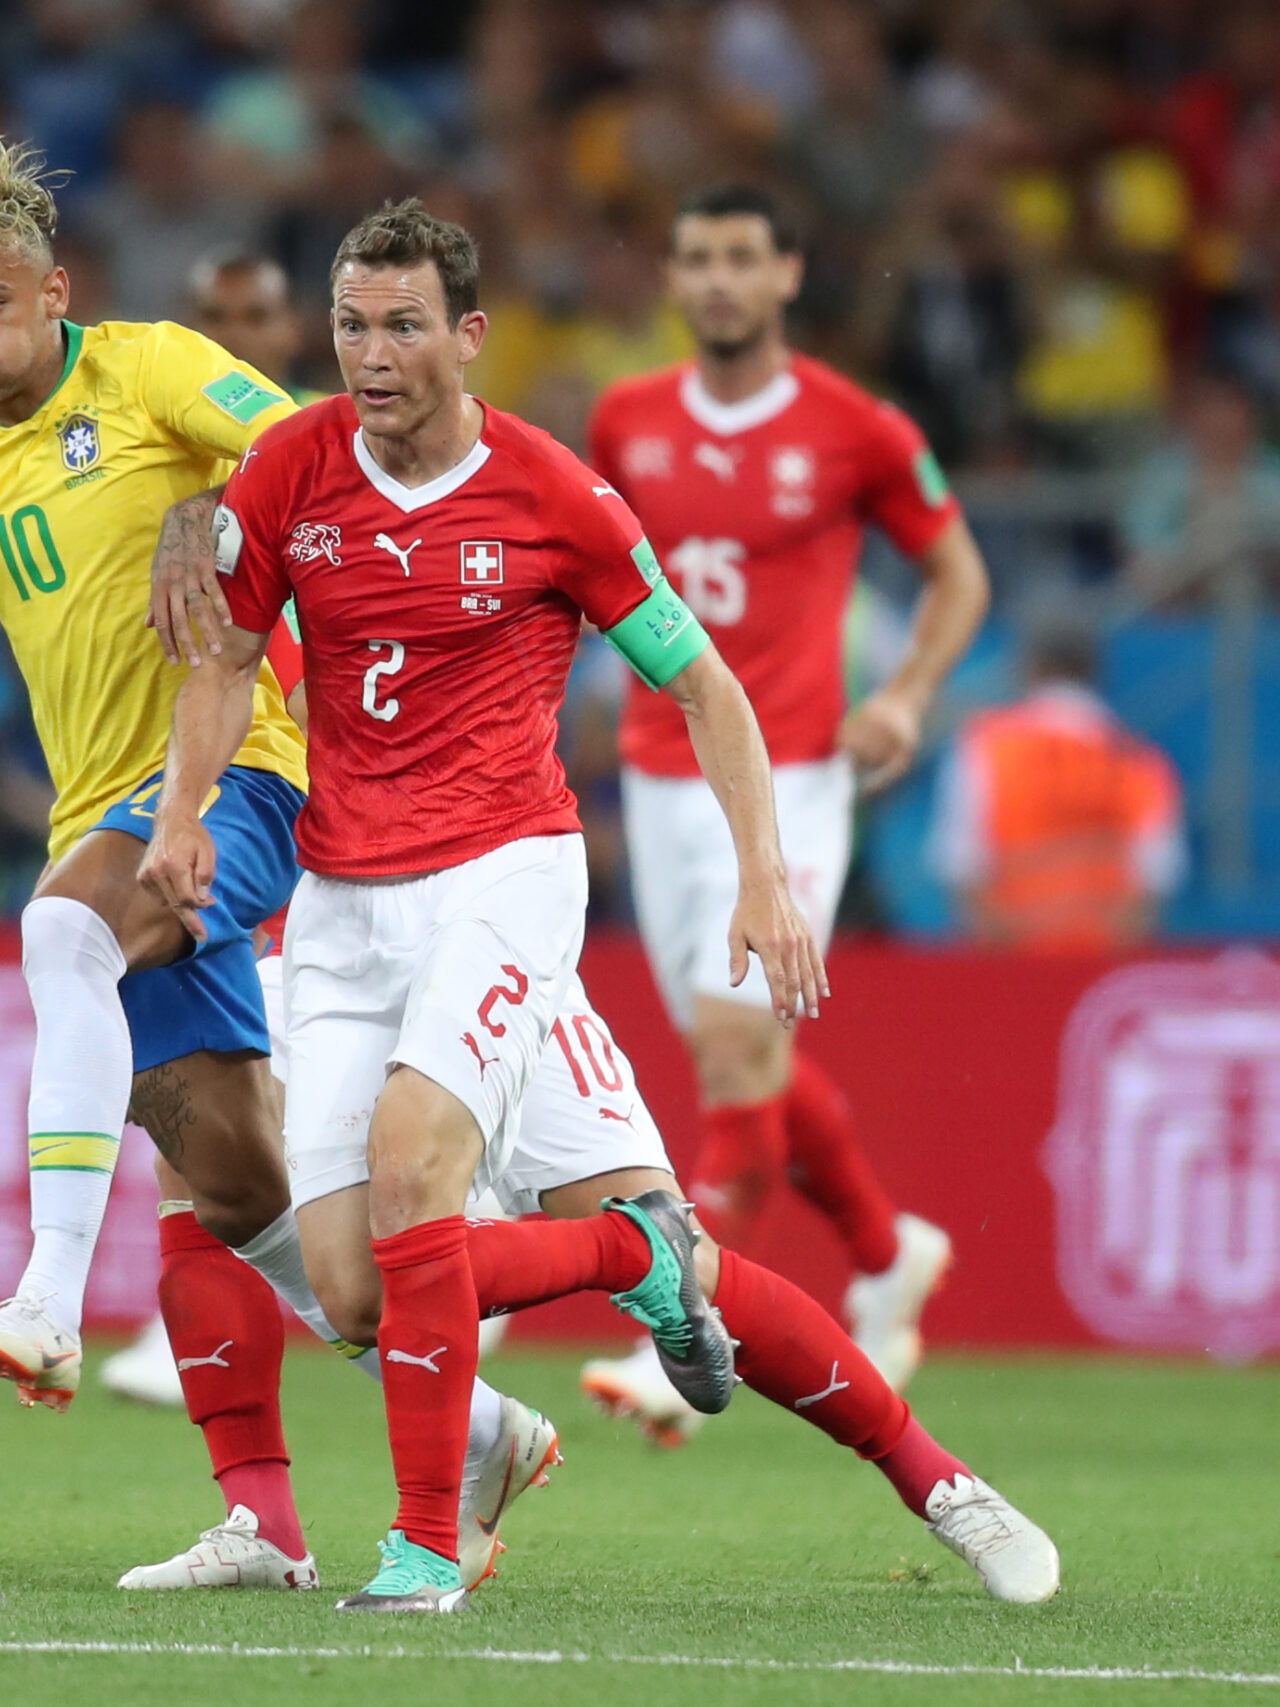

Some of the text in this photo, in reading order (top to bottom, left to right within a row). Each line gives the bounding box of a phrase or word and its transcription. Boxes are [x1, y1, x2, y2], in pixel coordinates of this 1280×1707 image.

[486, 599, 502, 611] SUI
[667, 534, 749, 628] 15
[362, 638, 406, 722] 2
[477, 964, 528, 1038] 2
[543, 1013, 624, 1098] 10
